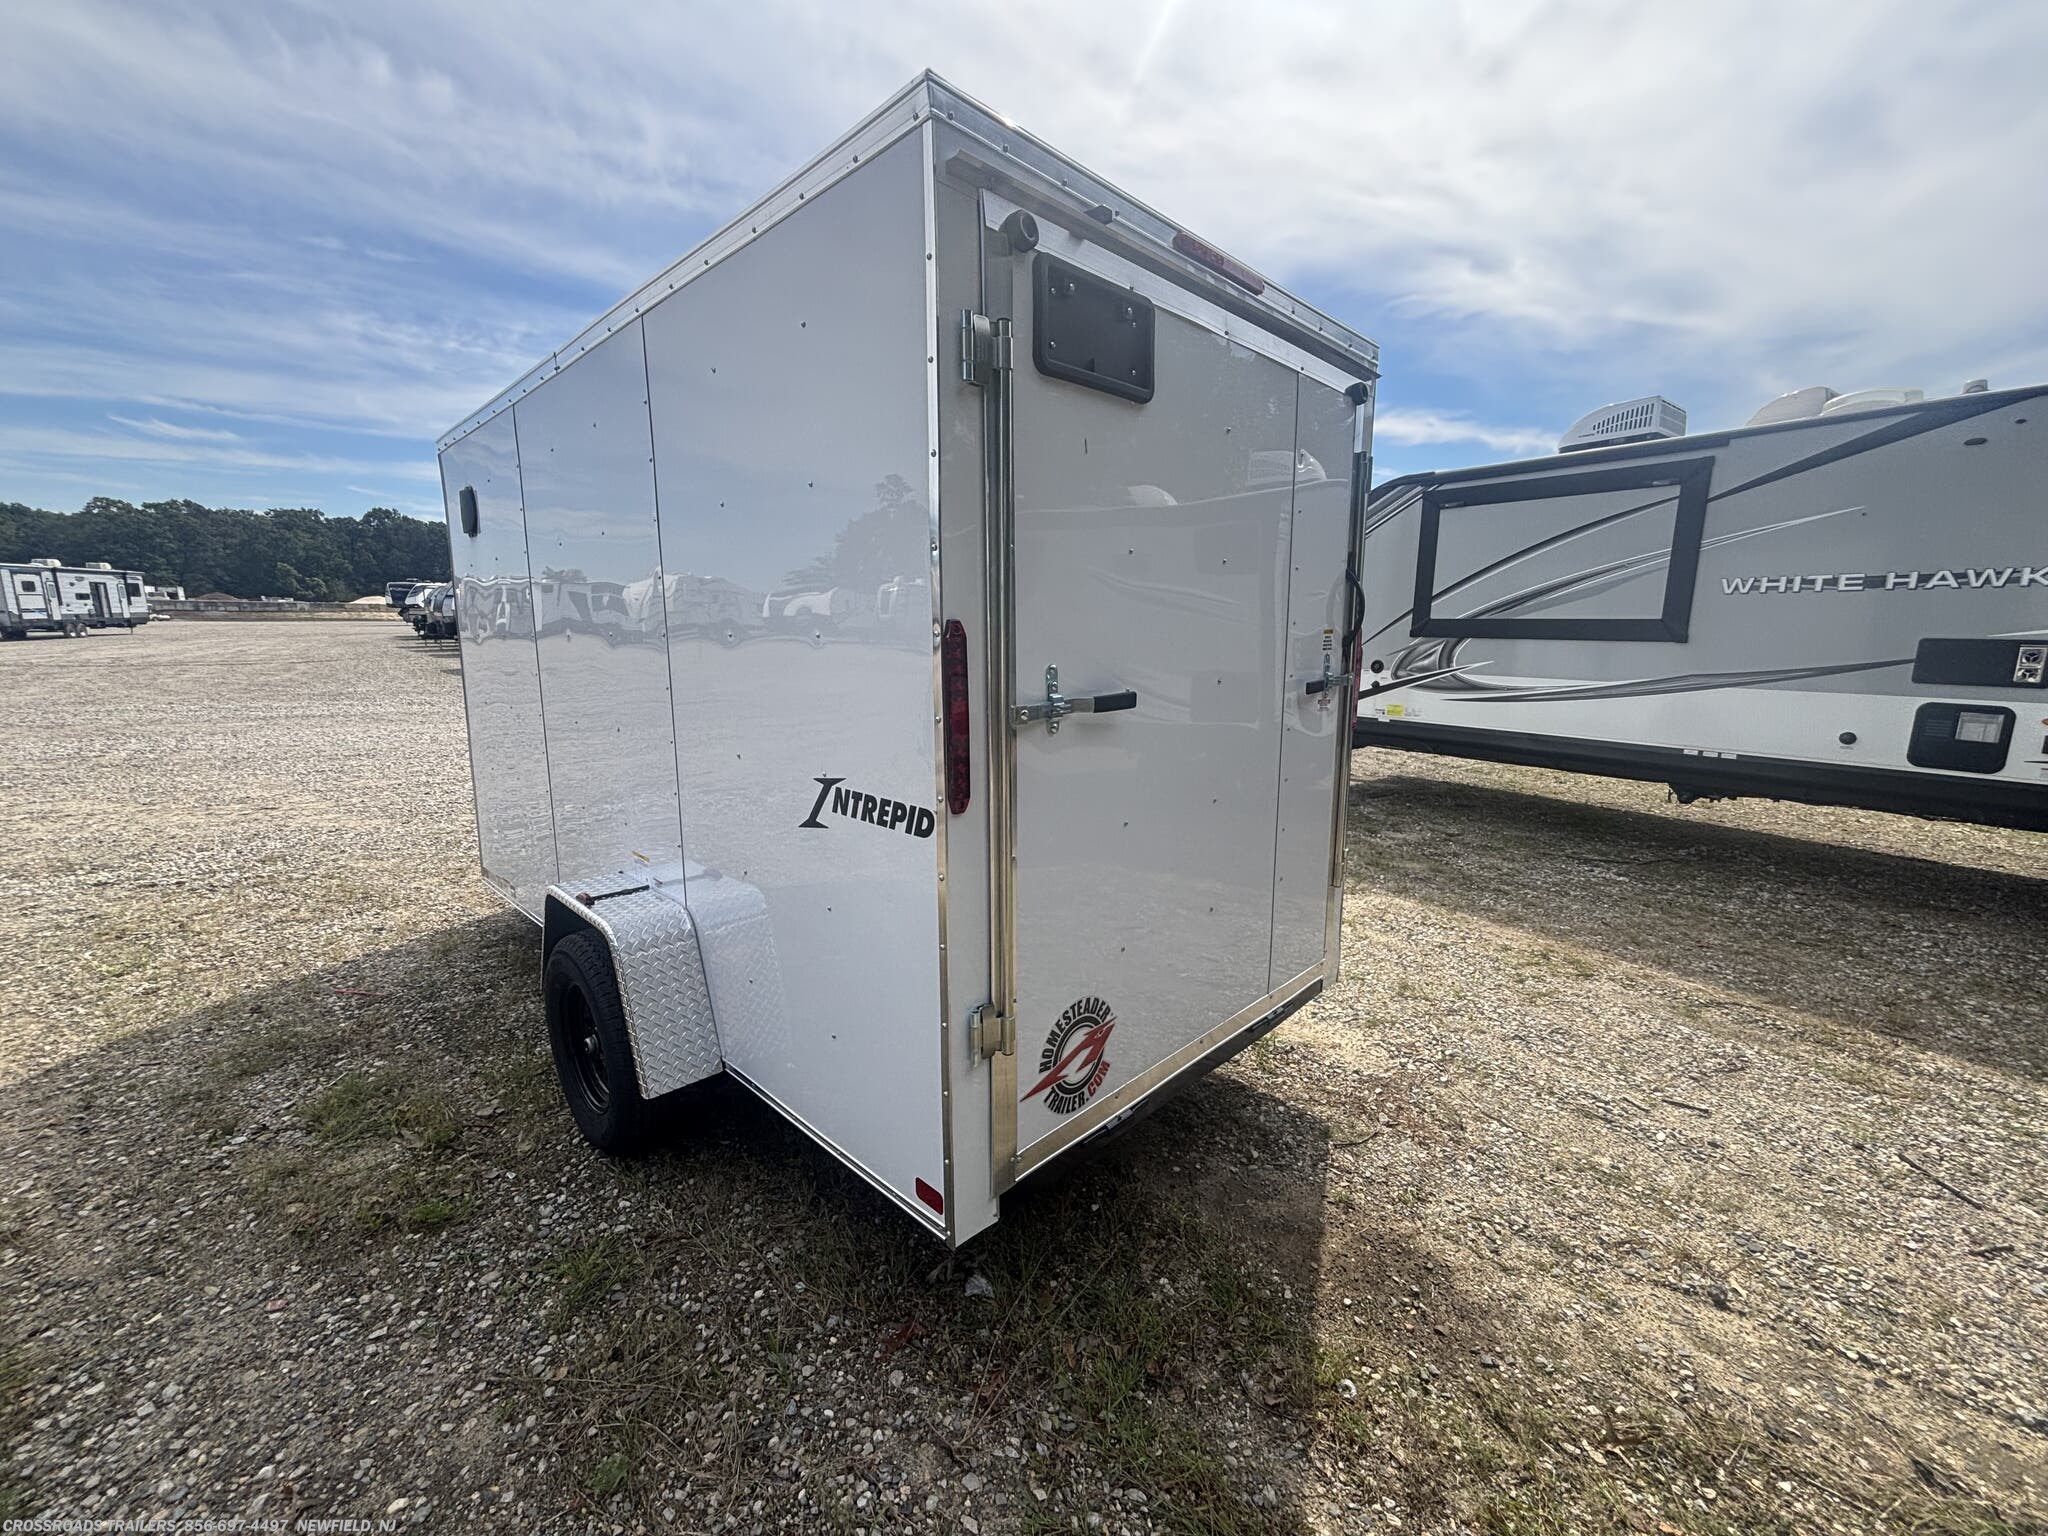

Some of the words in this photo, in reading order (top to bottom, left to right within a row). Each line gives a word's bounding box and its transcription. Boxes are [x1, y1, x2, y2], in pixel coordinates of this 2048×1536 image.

[1721, 573, 1867, 594] WHITE
[1885, 565, 2048, 592] HAWK
[798, 777, 936, 839] INTREPID
[1039, 997, 1112, 1074] HOMESTEADER
